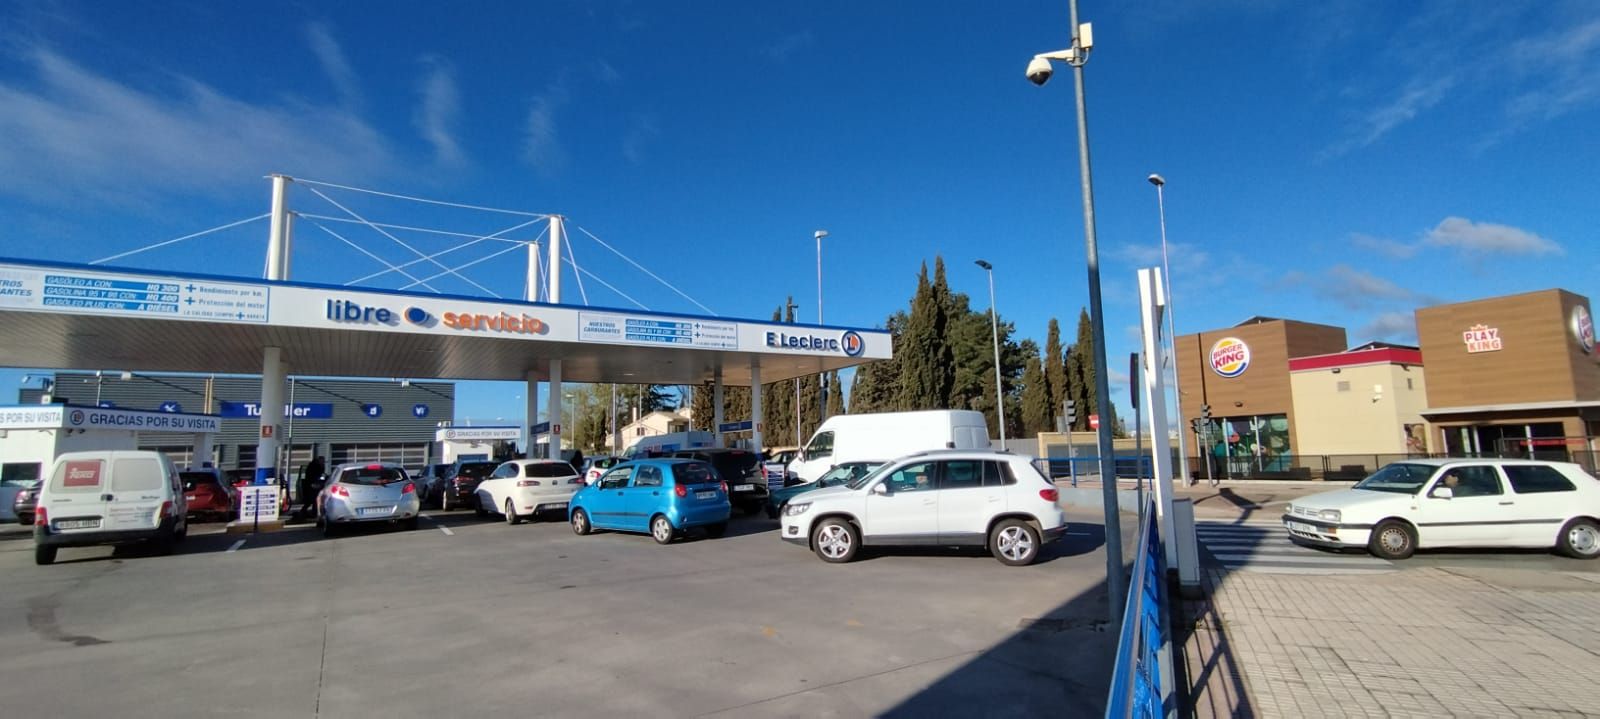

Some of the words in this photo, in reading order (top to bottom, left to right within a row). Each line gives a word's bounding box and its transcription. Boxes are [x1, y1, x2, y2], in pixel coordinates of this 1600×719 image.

[326, 299, 391, 323] libre
[442, 311, 543, 334] servicio
[781, 332, 838, 350] Leclerc
[1464, 329, 1496, 343] PLAY
[1213, 343, 1244, 360] BURGER
[1468, 340, 1500, 352] KING
[1215, 350, 1245, 369] KING
[89, 412, 144, 427] GRACIAS
[146, 416, 169, 428] POR
[171, 417, 186, 428] SU
[187, 418, 216, 430] VISITA
